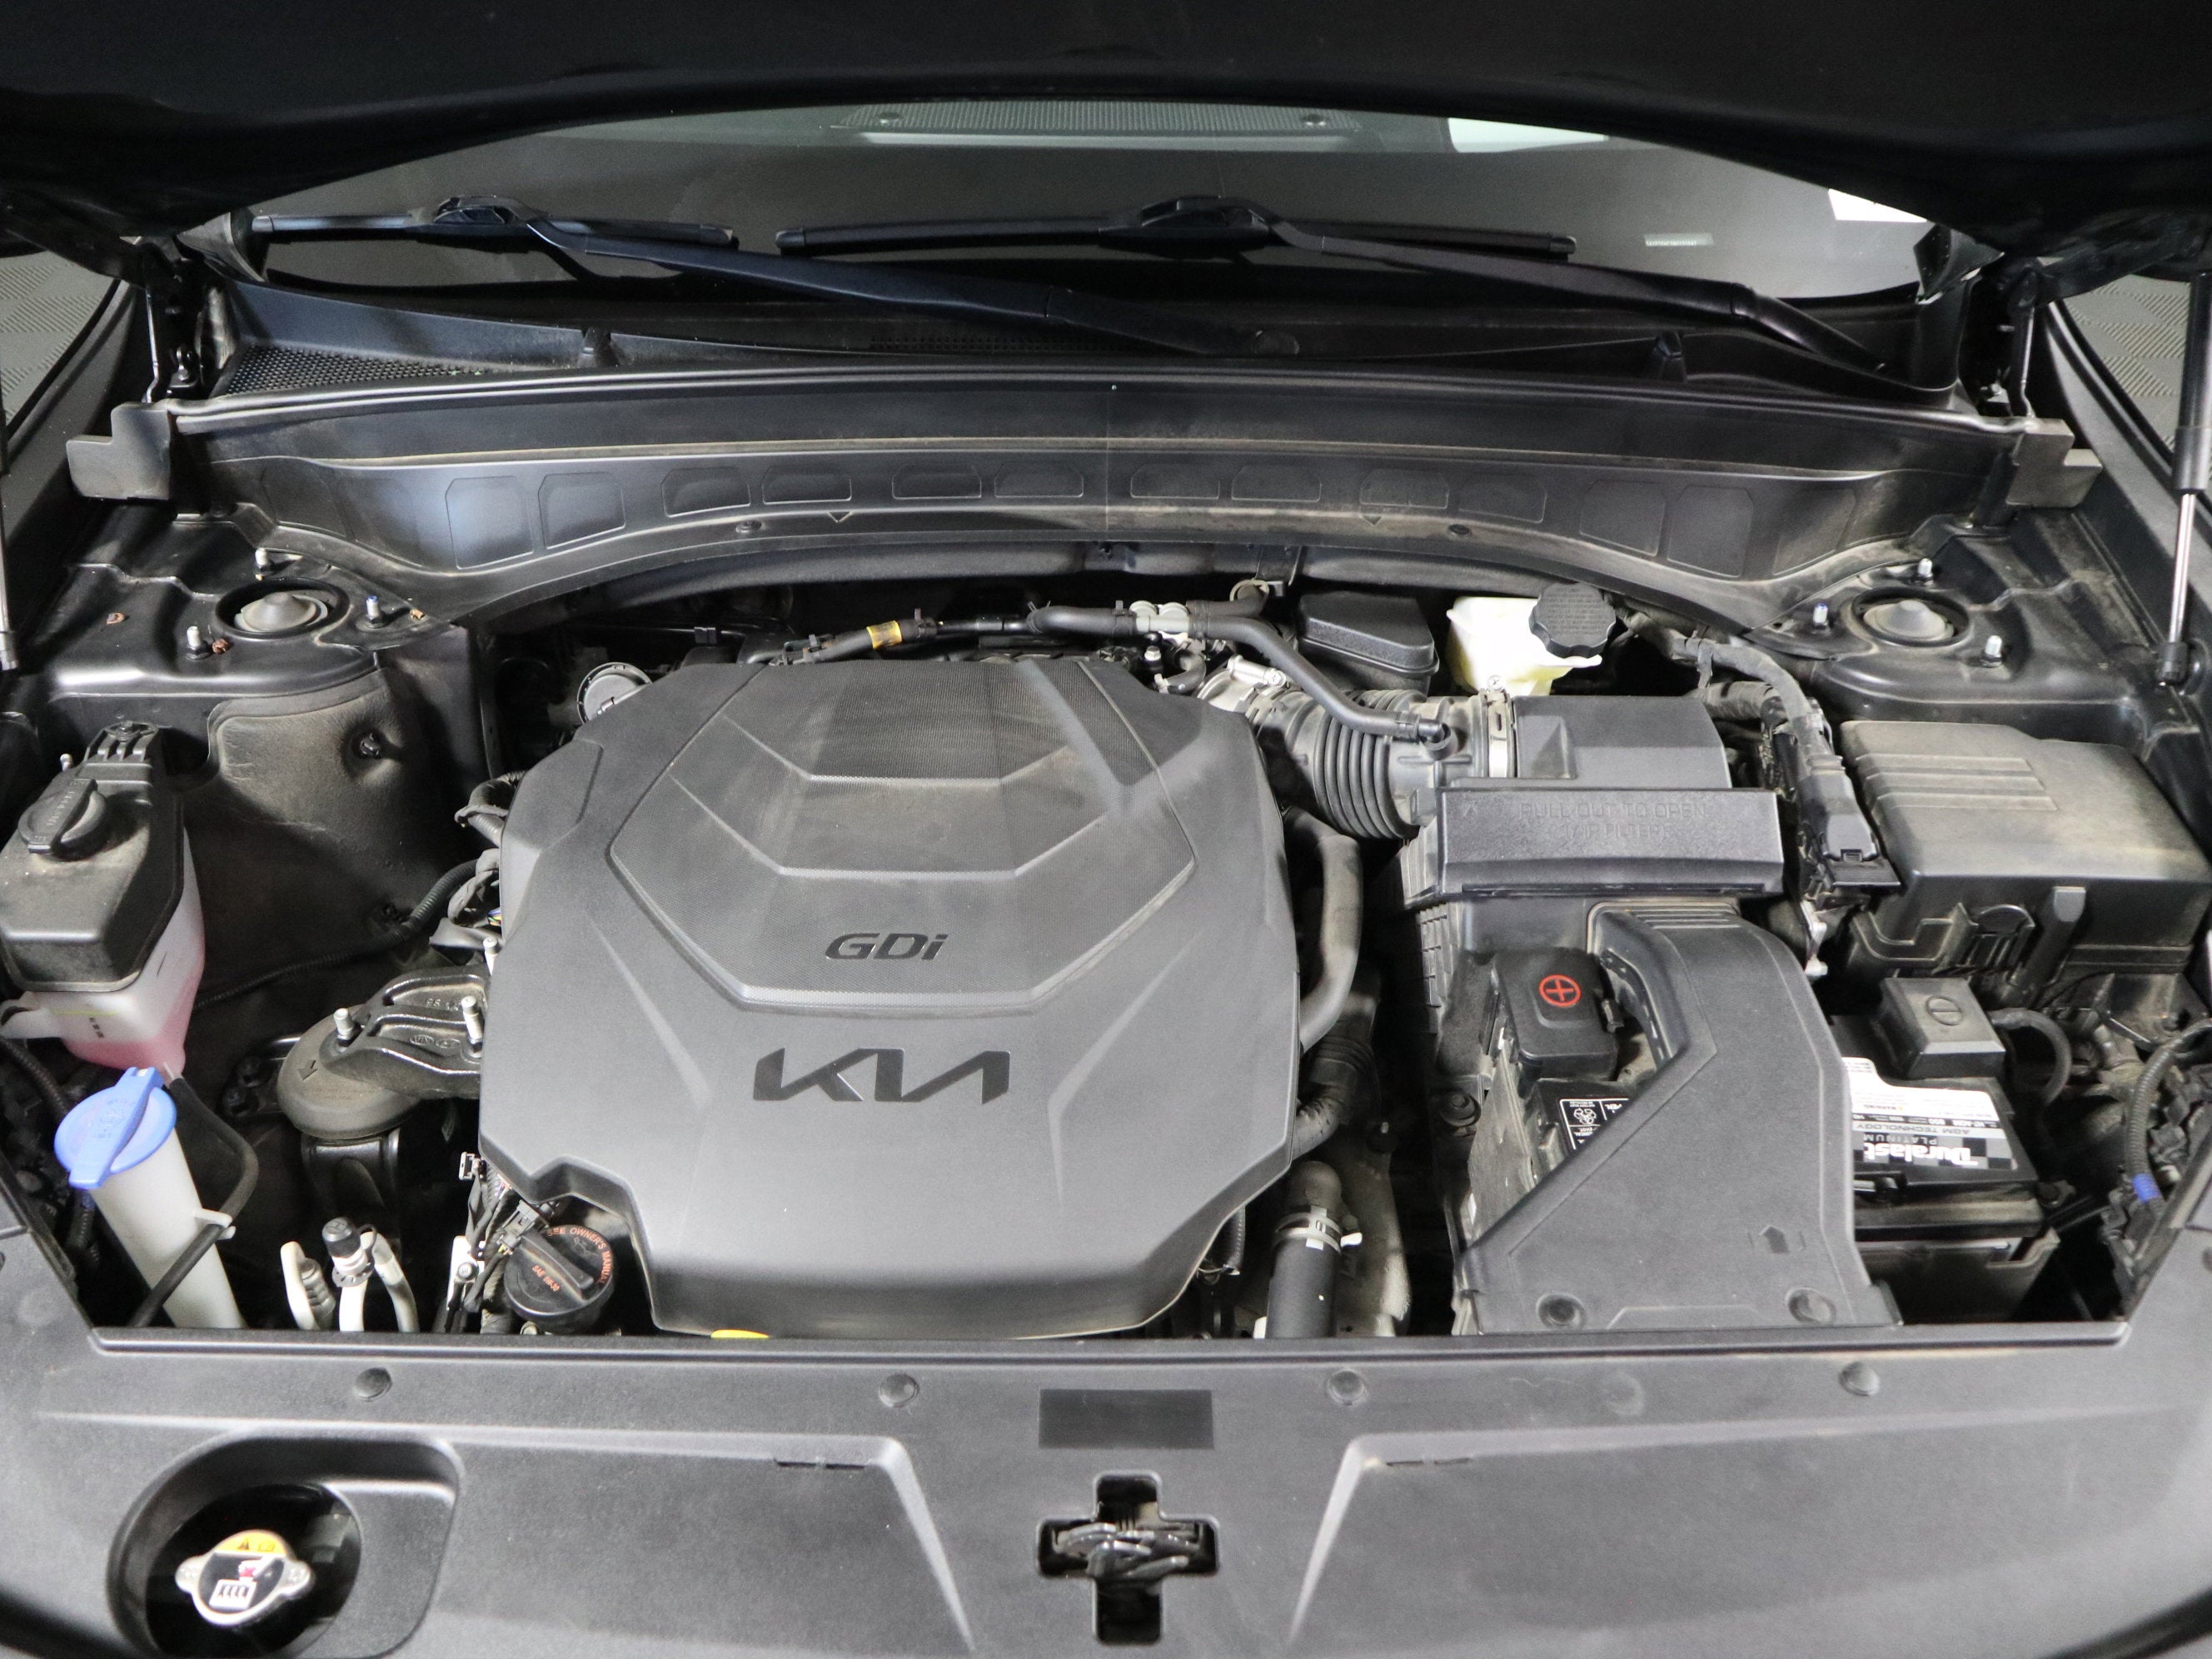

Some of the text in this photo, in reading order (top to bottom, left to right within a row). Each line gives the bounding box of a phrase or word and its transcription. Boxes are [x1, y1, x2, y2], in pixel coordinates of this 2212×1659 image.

[825, 933, 949, 960] GDi
[753, 1046, 1010, 1104] KIA
[1857, 1123, 1937, 1133] TECHNOLOGY
[1863, 1133, 1937, 1145] PLATINUM
[1863, 1142, 1978, 1166] Duralast
[546, 1228, 566, 1237] SEE
[570, 1228, 606, 1249] OWNER'S
[531, 1265, 546, 1278] SAE
